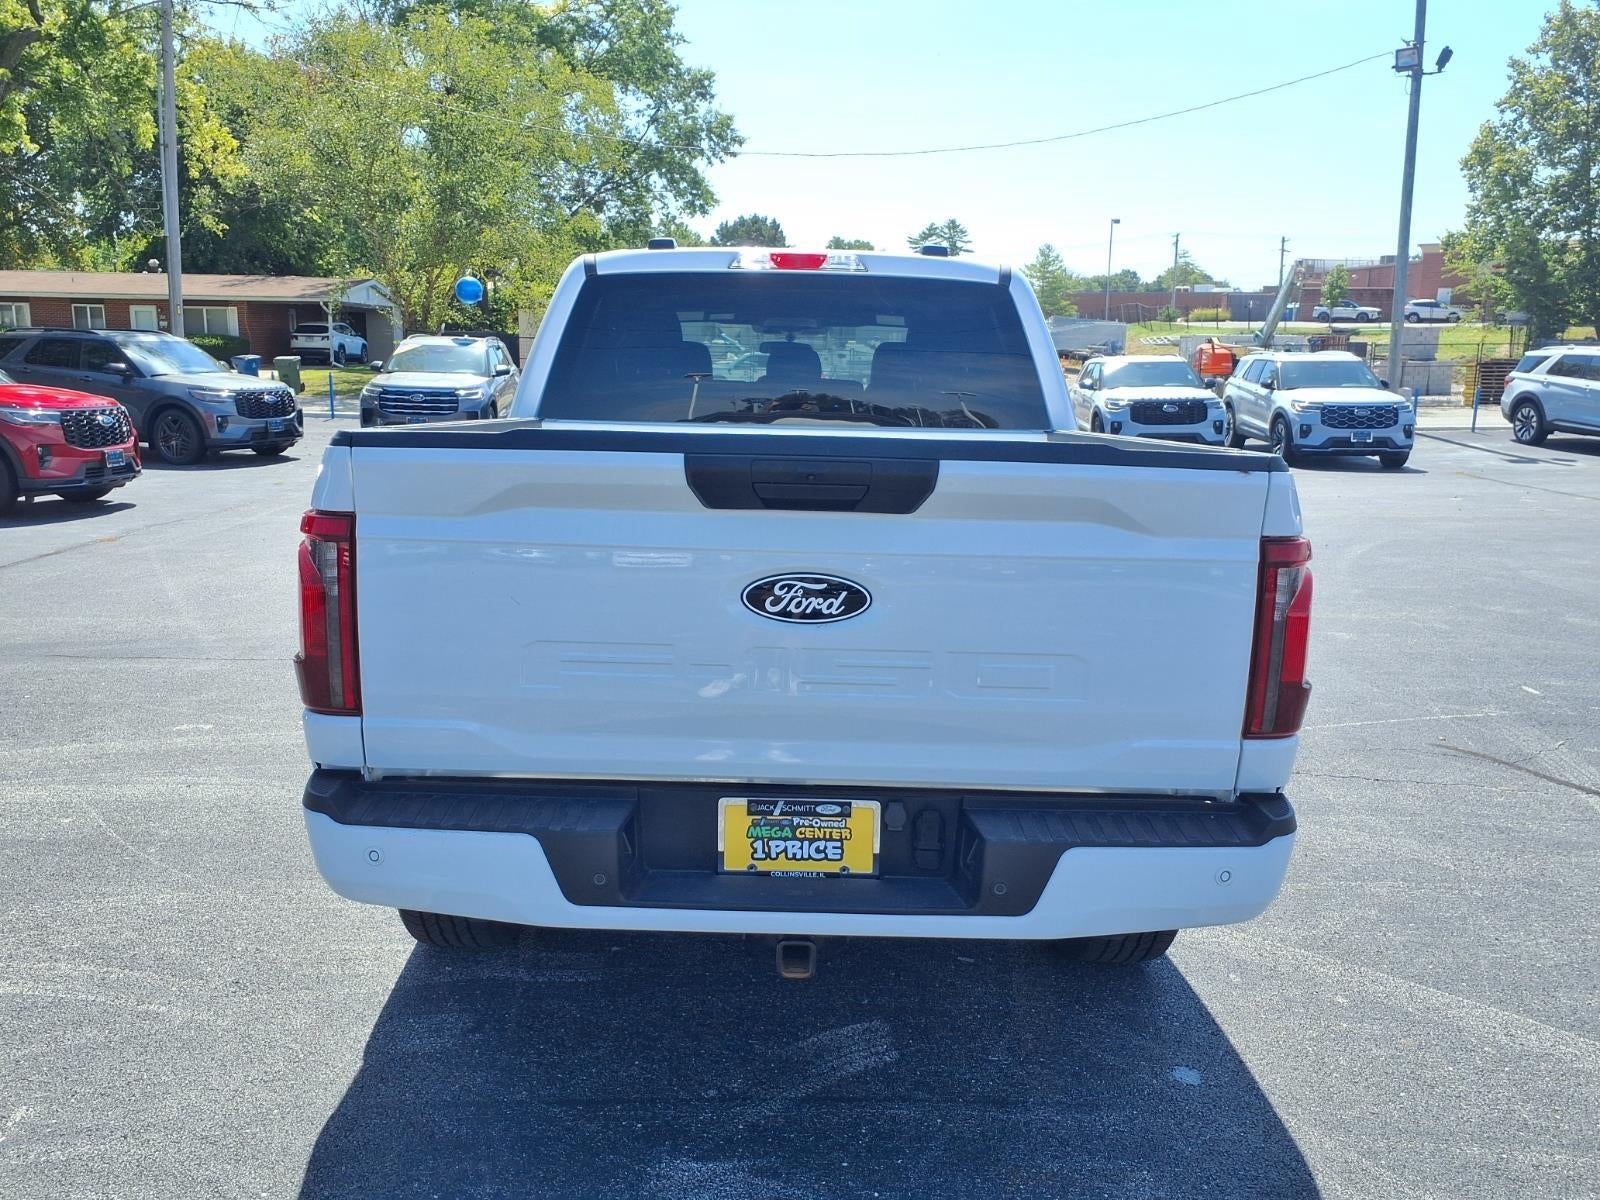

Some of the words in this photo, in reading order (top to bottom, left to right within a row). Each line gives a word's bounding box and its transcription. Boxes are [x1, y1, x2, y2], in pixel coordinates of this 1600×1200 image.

[765, 580, 848, 615] Ford
[782, 804, 815, 812] SCHMITT
[793, 817, 846, 828] Pre-Owned
[748, 827, 792, 838] MEGA
[795, 828, 851, 839] CENTER
